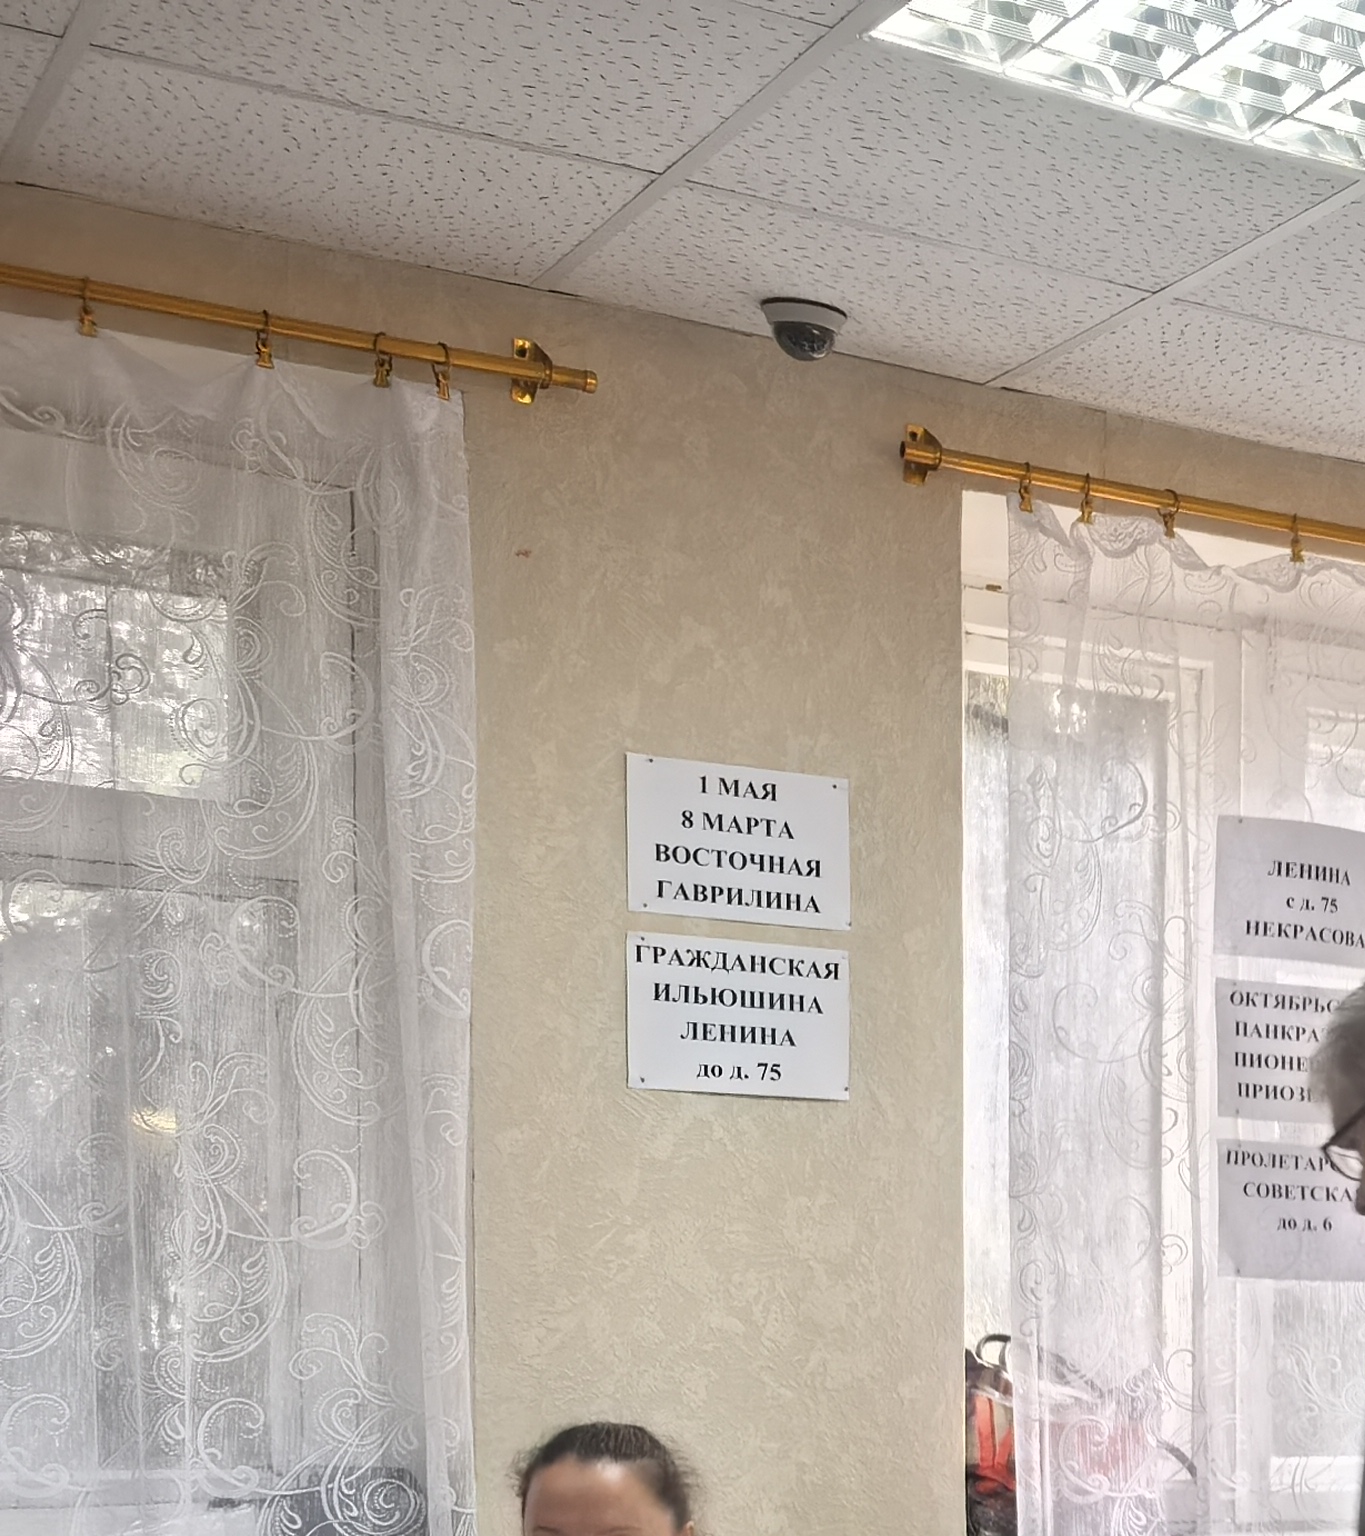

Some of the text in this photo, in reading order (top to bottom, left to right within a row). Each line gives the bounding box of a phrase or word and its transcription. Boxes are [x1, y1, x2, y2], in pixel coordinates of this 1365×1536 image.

[700, 775, 777, 801] 1 МАЯ
[681, 810, 794, 839] 8 МАРТА
[655, 843, 821, 878] ВОСТОЧНАЯ
[1267, 860, 1350, 886] ЛЕНИНА
[656, 879, 821, 914] ГАВРИЛИНА
[1286, 896, 1338, 914] с д. 75
[1246, 920, 1365, 949] НЕКРАСОВА
[635, 945, 840, 980] ГРАЖДАНСКАЯ
[653, 982, 824, 1014] ИЛЬЮШИНА
[680, 1021, 797, 1047] ЛЕНИНА
[696, 1063, 782, 1082] до д. 75
[1276, 1216, 1332, 1232] до д. 6
